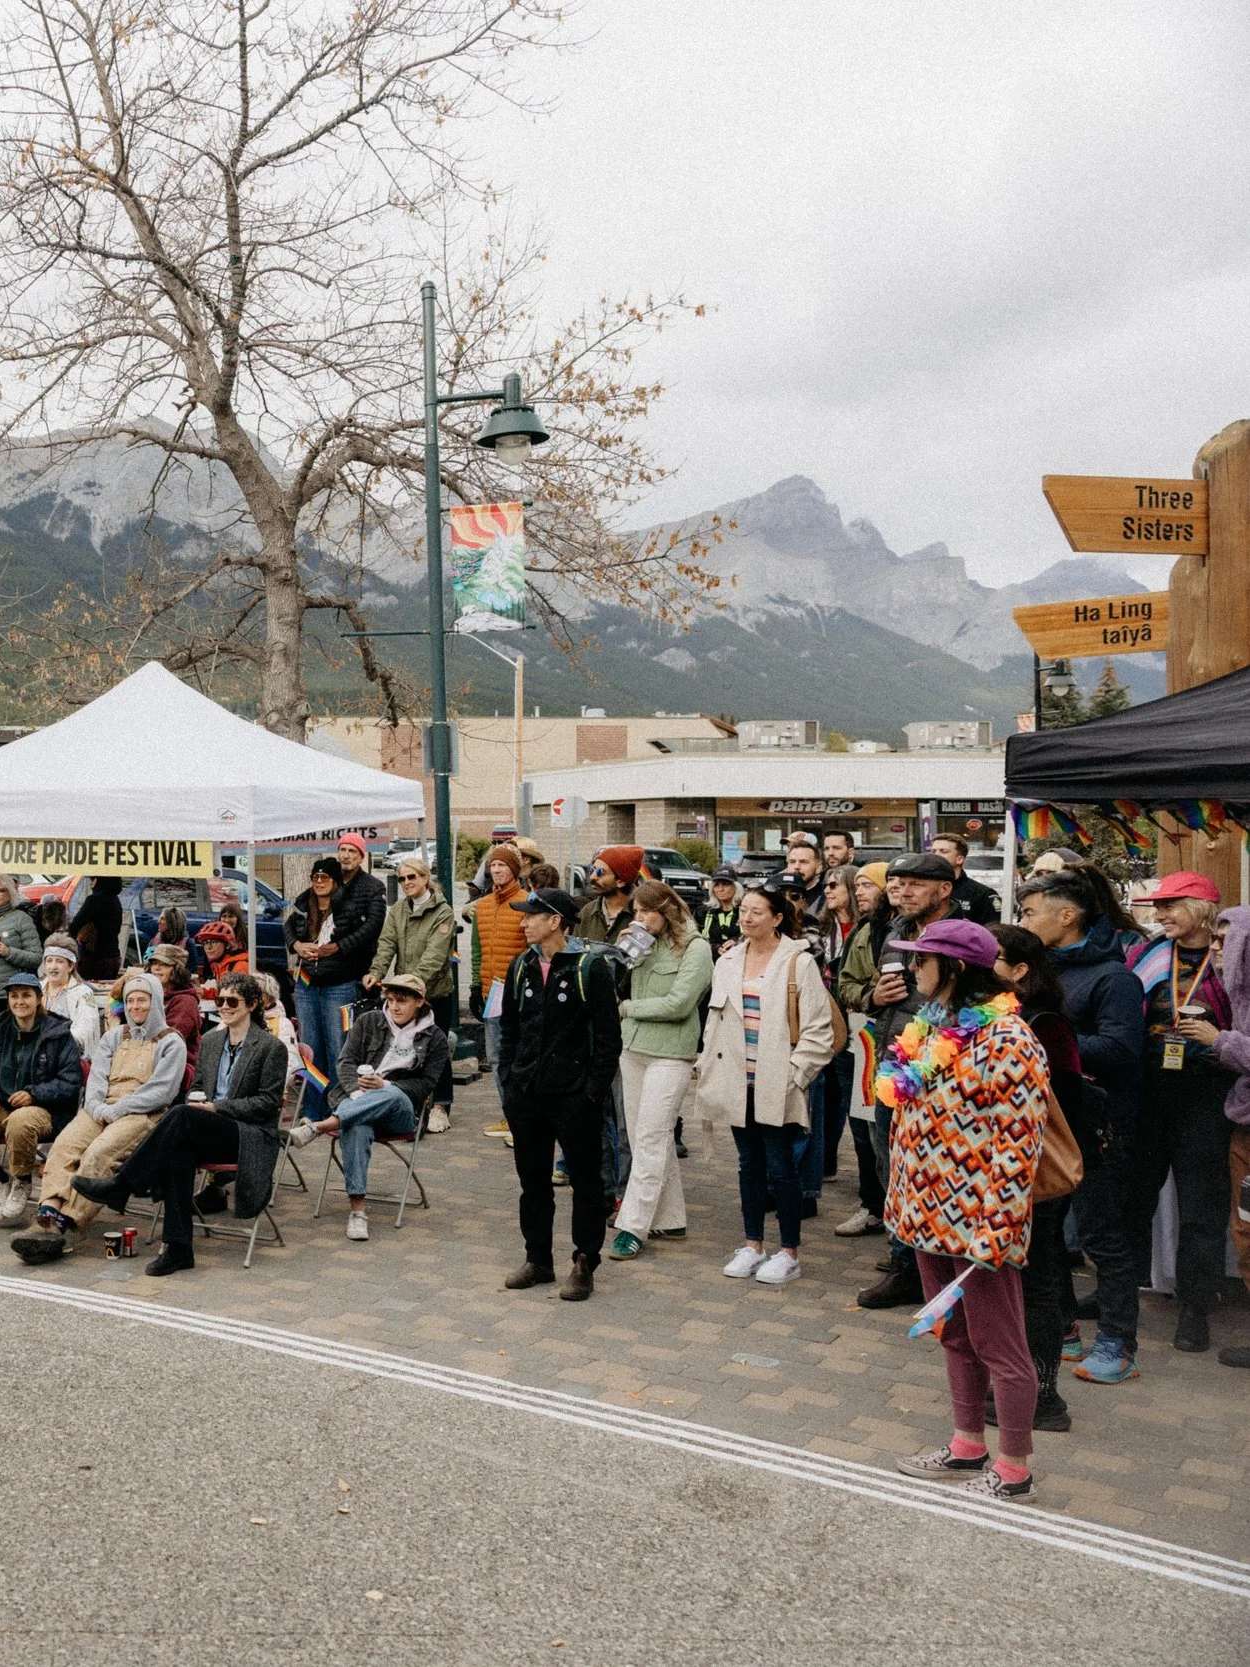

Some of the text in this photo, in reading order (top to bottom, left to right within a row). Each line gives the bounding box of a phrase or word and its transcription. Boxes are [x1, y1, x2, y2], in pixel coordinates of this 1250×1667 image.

[1134, 485, 1193, 509] Three
[1122, 516, 1193, 541] Sisters
[1074, 601, 1152, 622] Ha Ling
[768, 799, 856, 814] panago
[941, 801, 971, 812] RAMEN
[42, 839, 98, 865] PRIDE
[104, 840, 202, 867] FESTIVAL
